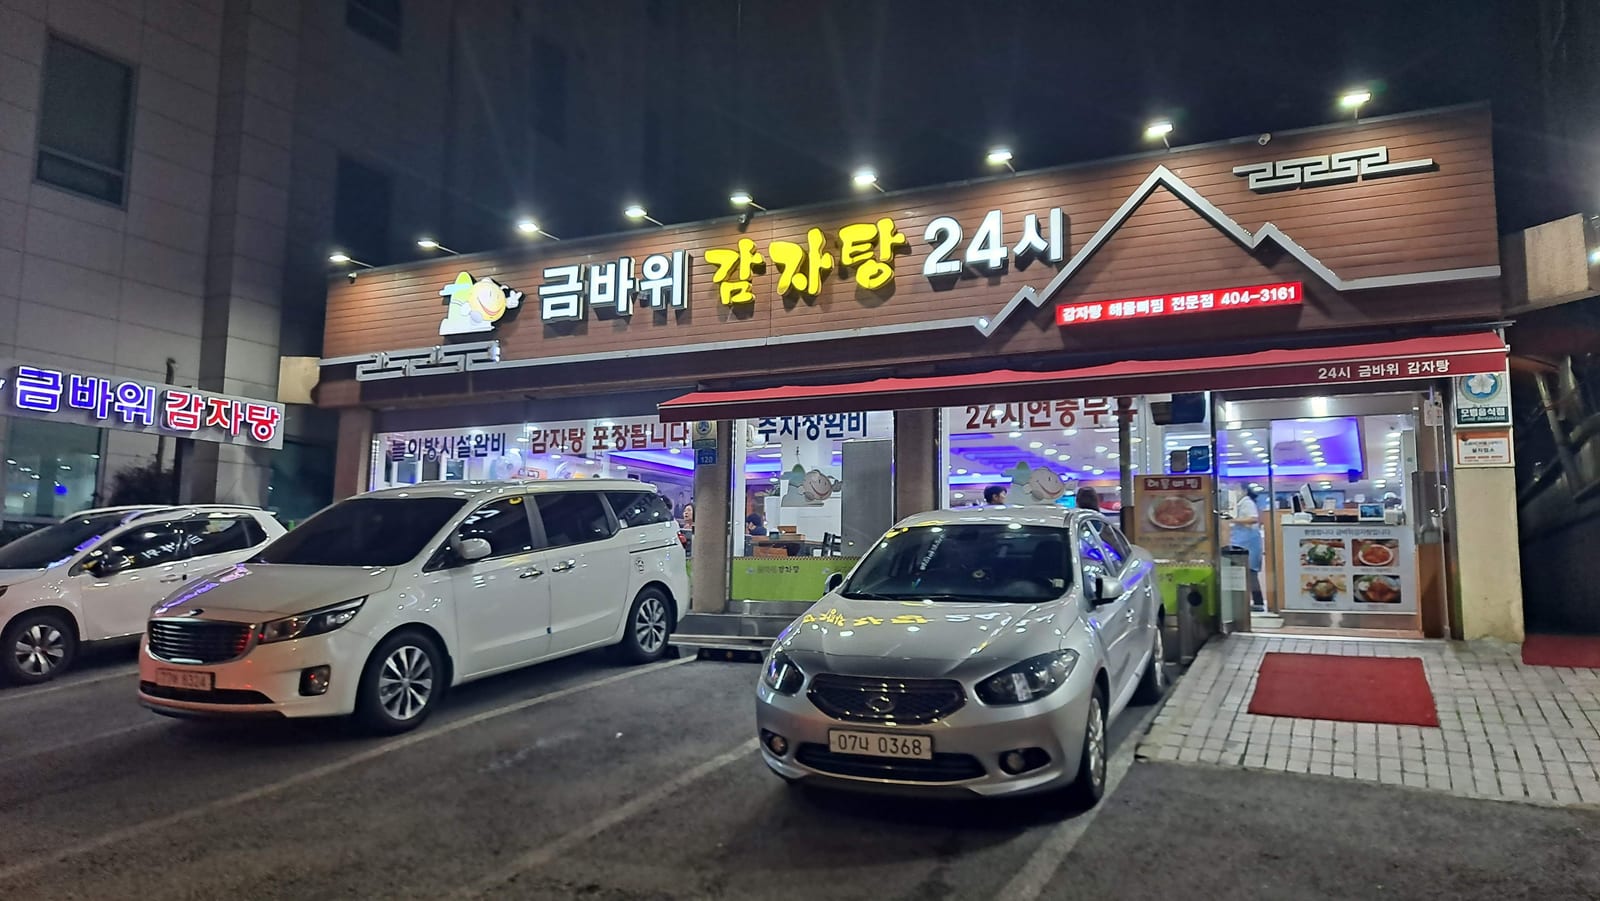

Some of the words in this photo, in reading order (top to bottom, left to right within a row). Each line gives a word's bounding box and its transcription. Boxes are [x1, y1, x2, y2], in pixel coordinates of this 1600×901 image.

[538, 250, 691, 322] 금바위
[704, 217, 907, 306] 감자탕
[922, 207, 1065, 278] 24시
[1062, 305, 1103, 323] 감자탕
[1171, 293, 1215, 312] 전문점
[1220, 286, 1296, 306] 404-3161
[1317, 365, 1351, 380] 24시
[1358, 362, 1399, 378] 금바위
[1407, 359, 1450, 374] 감자탕
[15, 365, 156, 426] 금바위
[164, 389, 280, 443] 감자탕
[391, 432, 507, 462] 놀이방시설완비
[531, 428, 586, 455] 감자탕
[592, 421, 690, 452] 포장됩니다
[878, 736, 923, 756] 0368
